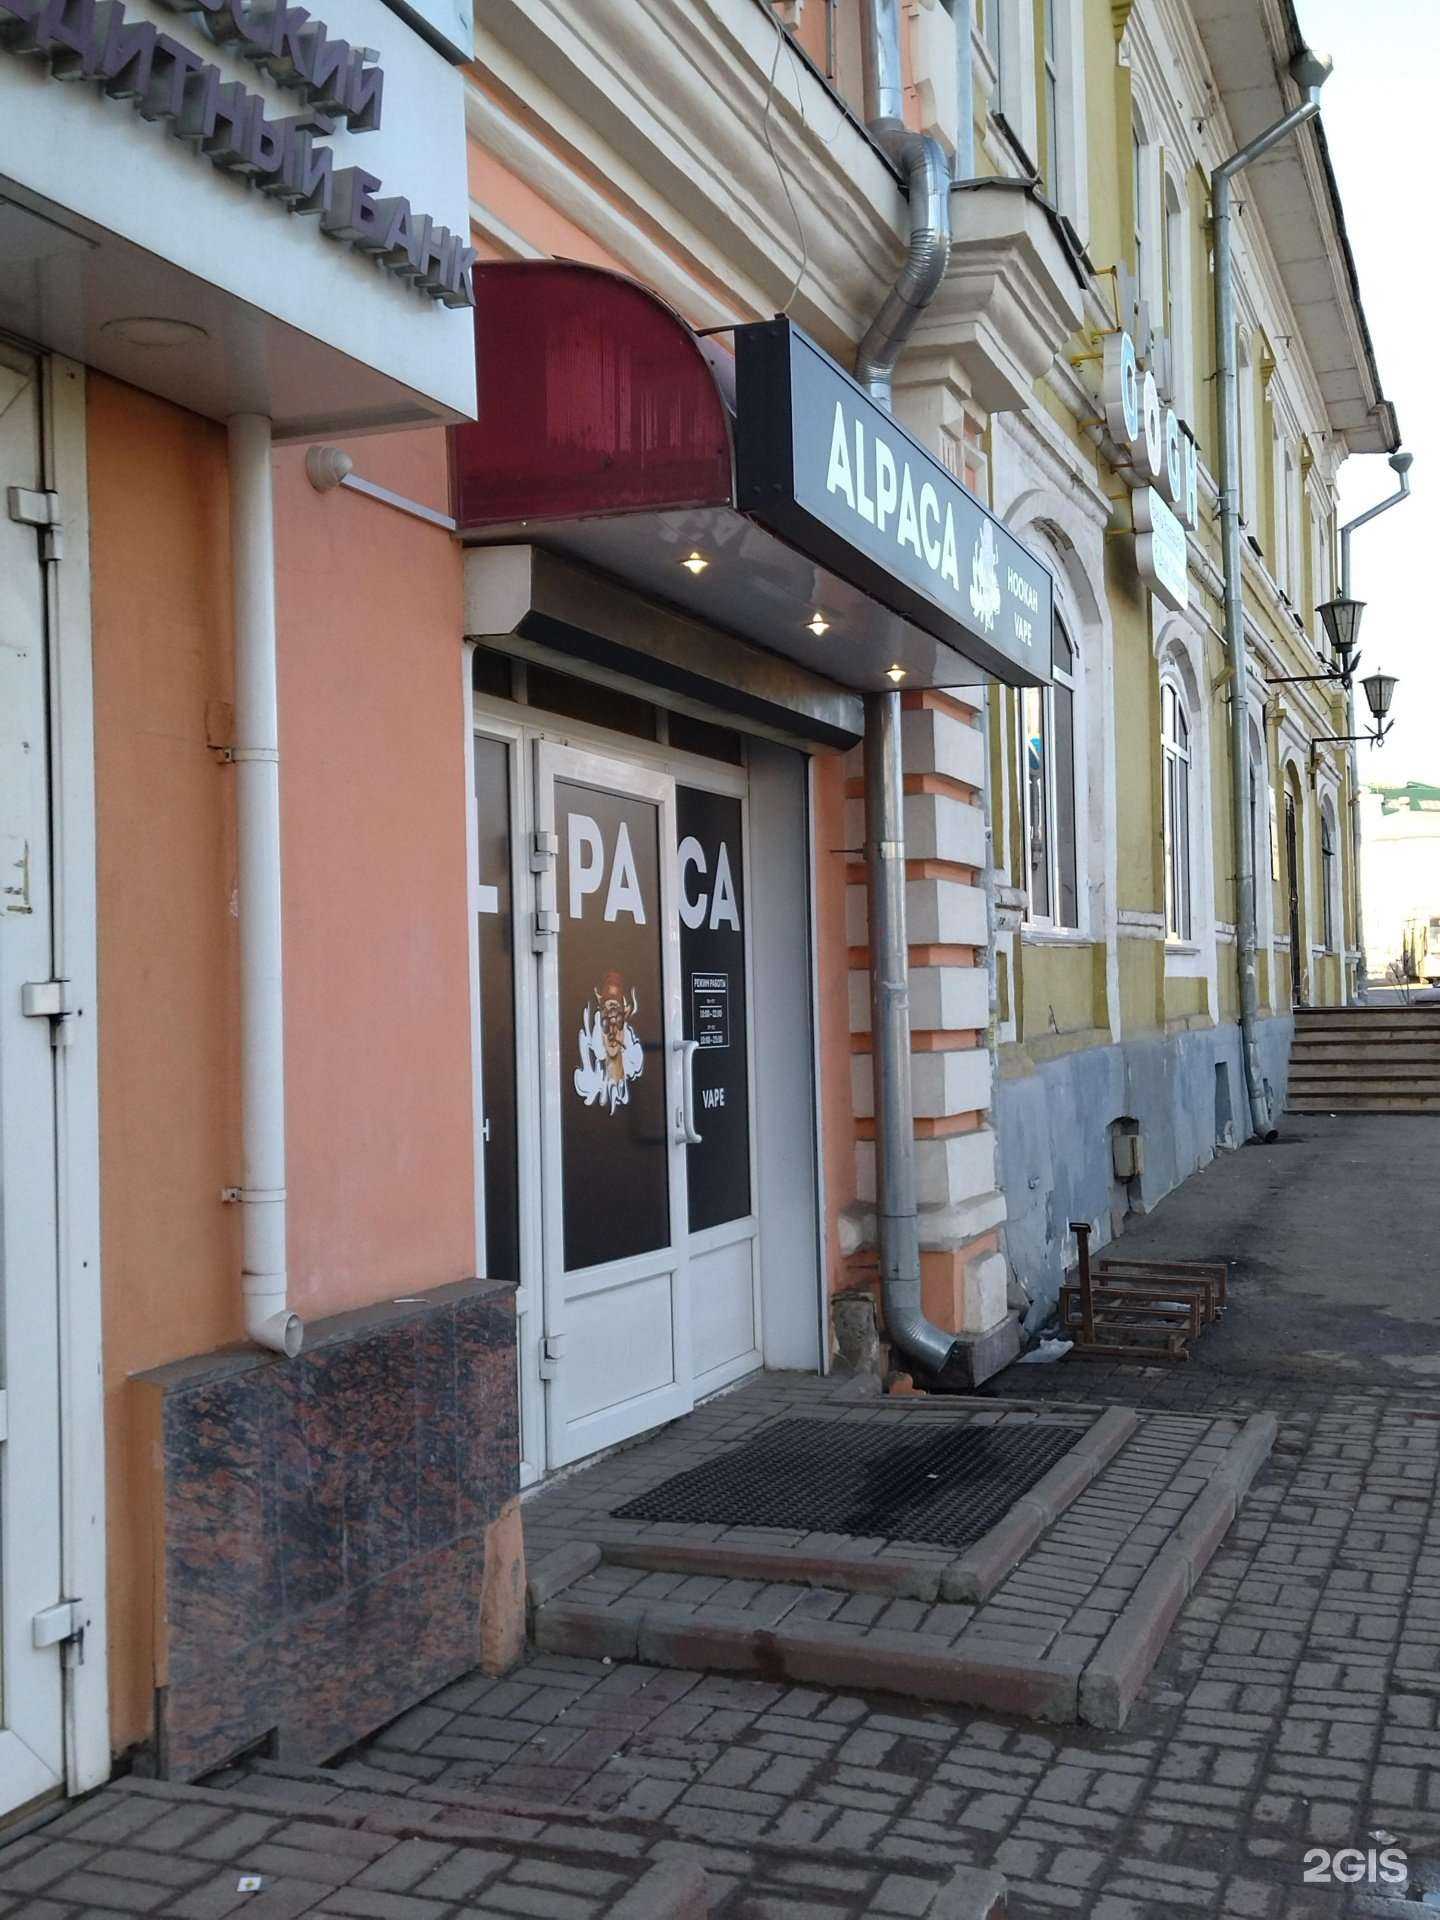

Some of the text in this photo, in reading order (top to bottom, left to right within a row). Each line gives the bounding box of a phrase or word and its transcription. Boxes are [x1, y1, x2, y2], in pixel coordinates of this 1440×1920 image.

[328, 165, 477, 309] БАНК
[826, 400, 960, 592] ALPACA
[1007, 566, 1038, 614] HOOKAH
[1014, 611, 1032, 648] VAPE
[702, 1088, 725, 1109] VAPE
